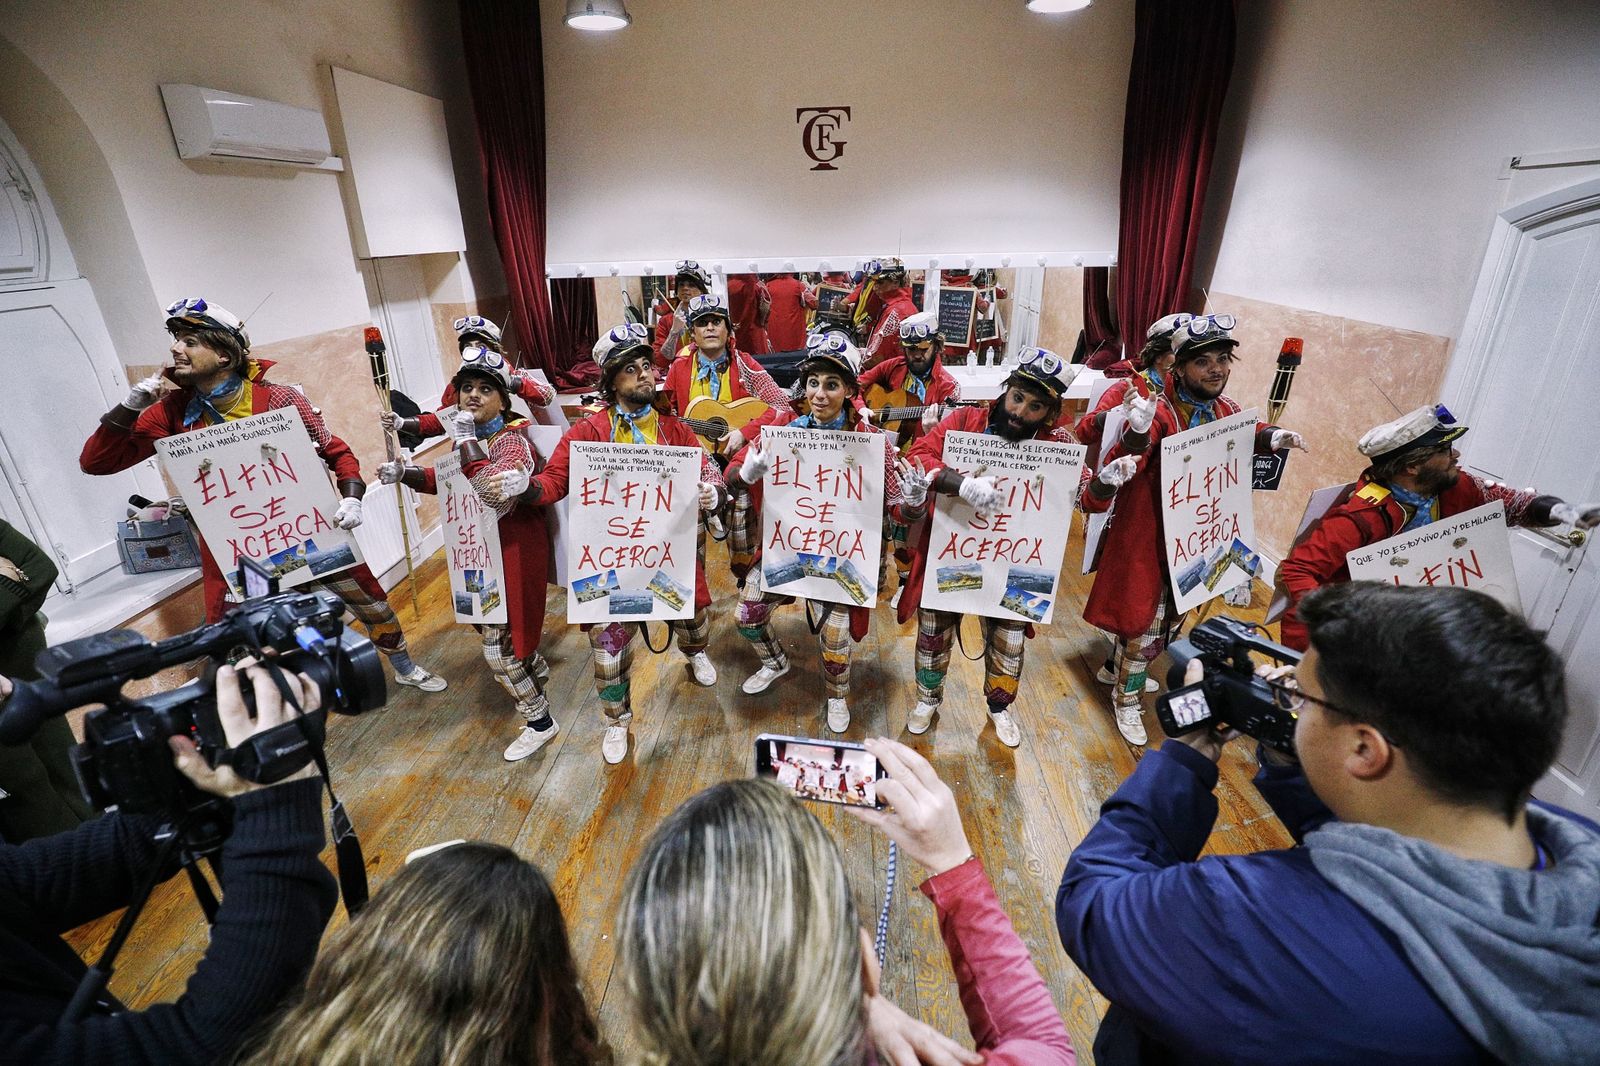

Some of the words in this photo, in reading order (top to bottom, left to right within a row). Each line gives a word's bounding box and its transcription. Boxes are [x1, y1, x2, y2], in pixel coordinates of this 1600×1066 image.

[195, 432, 206, 440] LA
[246, 420, 256, 428] SU
[240, 428, 271, 442] BUENOS
[776, 430, 807, 440] MUERTE
[810, 432, 820, 441] ES
[822, 433, 835, 441] UNA
[835, 434, 856, 444] PLAYA
[858, 436, 871, 444] CON
[653, 448, 665, 457] POR
[788, 441, 807, 449] CARA
[967, 437, 977, 446] EN
[979, 439, 989, 448] SU
[990, 440, 1020, 452] PISCINA
[1023, 445, 1032, 453] SE
[1034, 446, 1043, 454] LE
[1042, 447, 1071, 457] CORTARA
[1071, 450, 1080, 458] LA
[1004, 452, 1015, 460] POR
[1015, 453, 1023, 461] LA
[1026, 454, 1042, 462] BOCA
[1044, 456, 1053, 464] EL
[771, 455, 811, 490] EL
[976, 458, 1008, 468] HOSPITAL
[193, 467, 237, 505] EL
[580, 477, 615, 506] EL
[1168, 472, 1200, 510] EL
[230, 496, 286, 529] SE
[446, 492, 459, 523] EL
[795, 497, 836, 523] SE
[968, 511, 1012, 532] SE
[1195, 497, 1222, 525] SE
[226, 506, 332, 566] ACERCA
[458, 523, 476, 545] SE
[607, 516, 650, 539] SE
[769, 520, 866, 561] ACERCA
[1173, 512, 1241, 567] ACERCA
[1377, 548, 1390, 558] YO
[1392, 537, 1421, 554] ESTOY
[1452, 525, 1458, 533] Y
[1460, 521, 1471, 530] DE
[452, 537, 492, 571] ACERCA
[578, 541, 675, 570] ACERCA
[938, 532, 1043, 566] ACERCA
